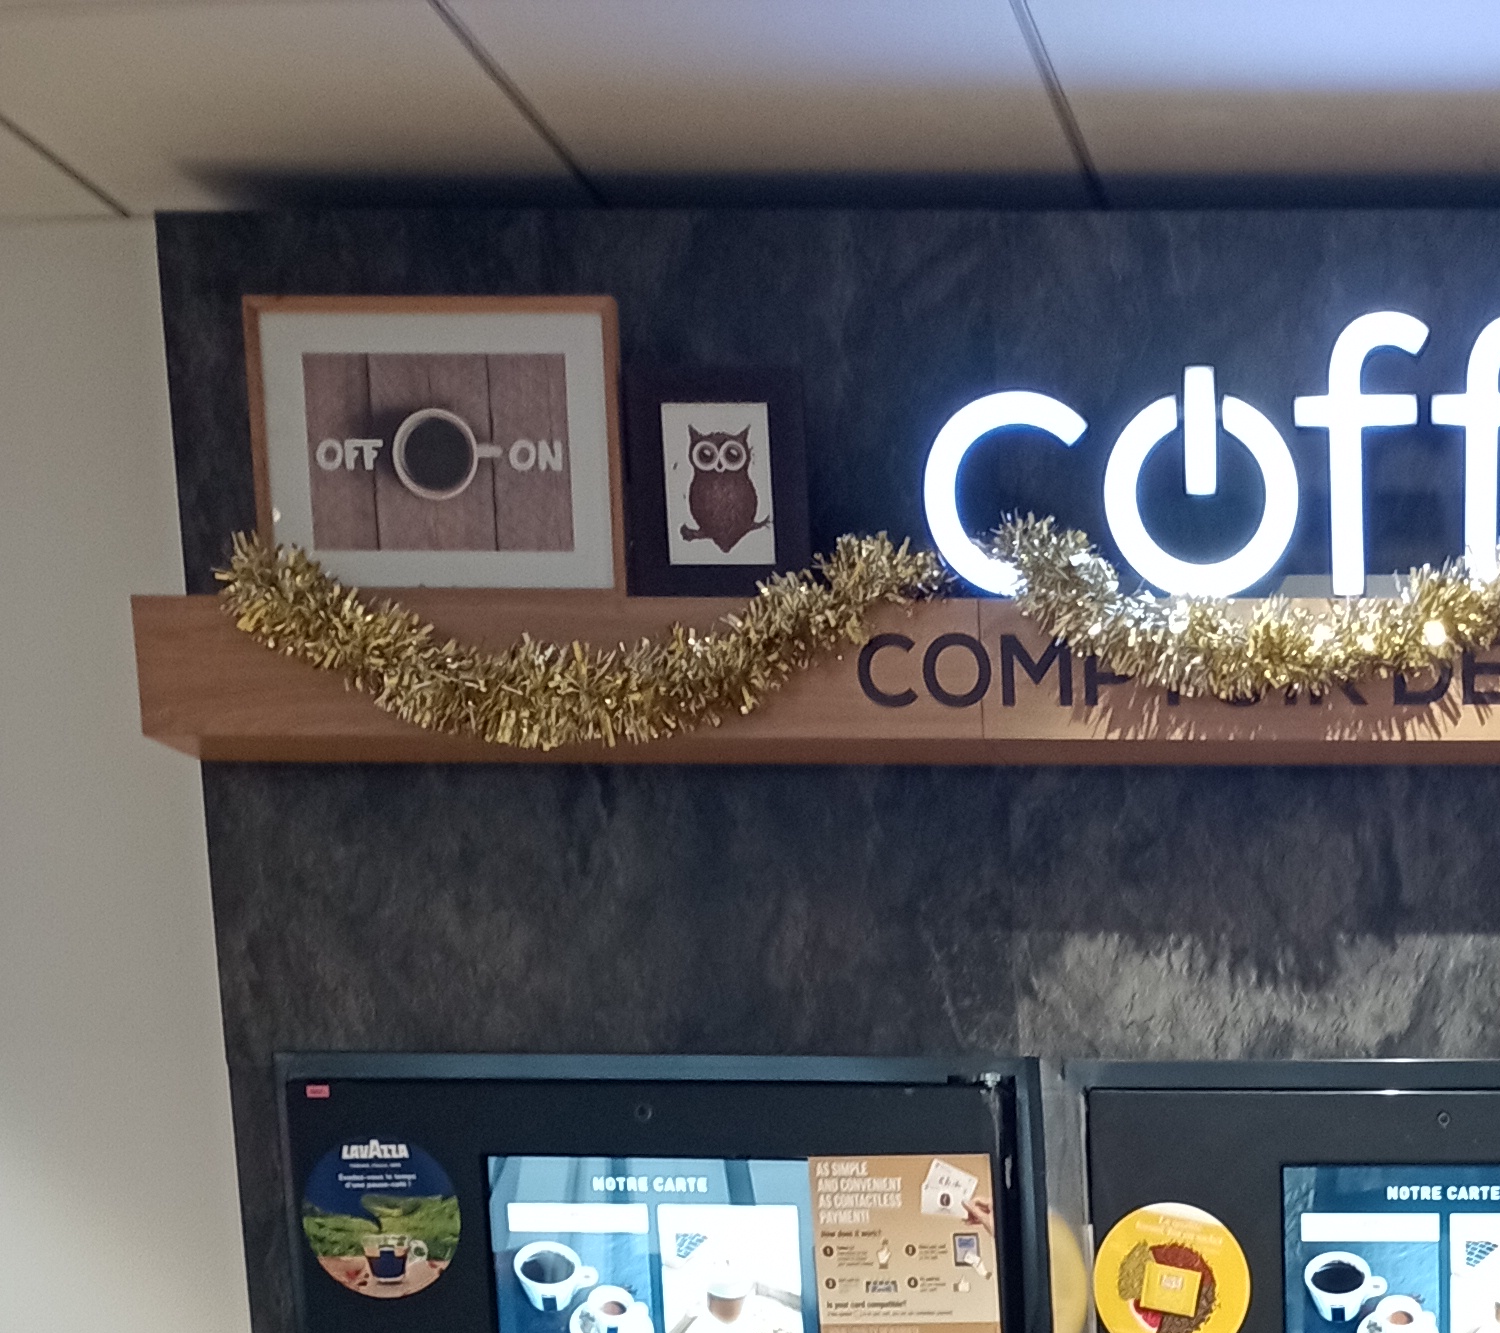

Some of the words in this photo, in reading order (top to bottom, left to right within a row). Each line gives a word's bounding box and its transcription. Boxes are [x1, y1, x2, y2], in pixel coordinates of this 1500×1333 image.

[316, 439, 383, 471] OFF
[508, 439, 563, 472] ON
[857, 633, 1369, 708] COMP
[341, 1139, 410, 1160] LAVAZZA
[831, 1161, 868, 1176] SIMPLE
[592, 1176, 648, 1193] NOTRE
[652, 1176, 707, 1193] CARTE
[1386, 1185, 1442, 1201] NOTRE
[1446, 1185, 1500, 1201] CARTE
